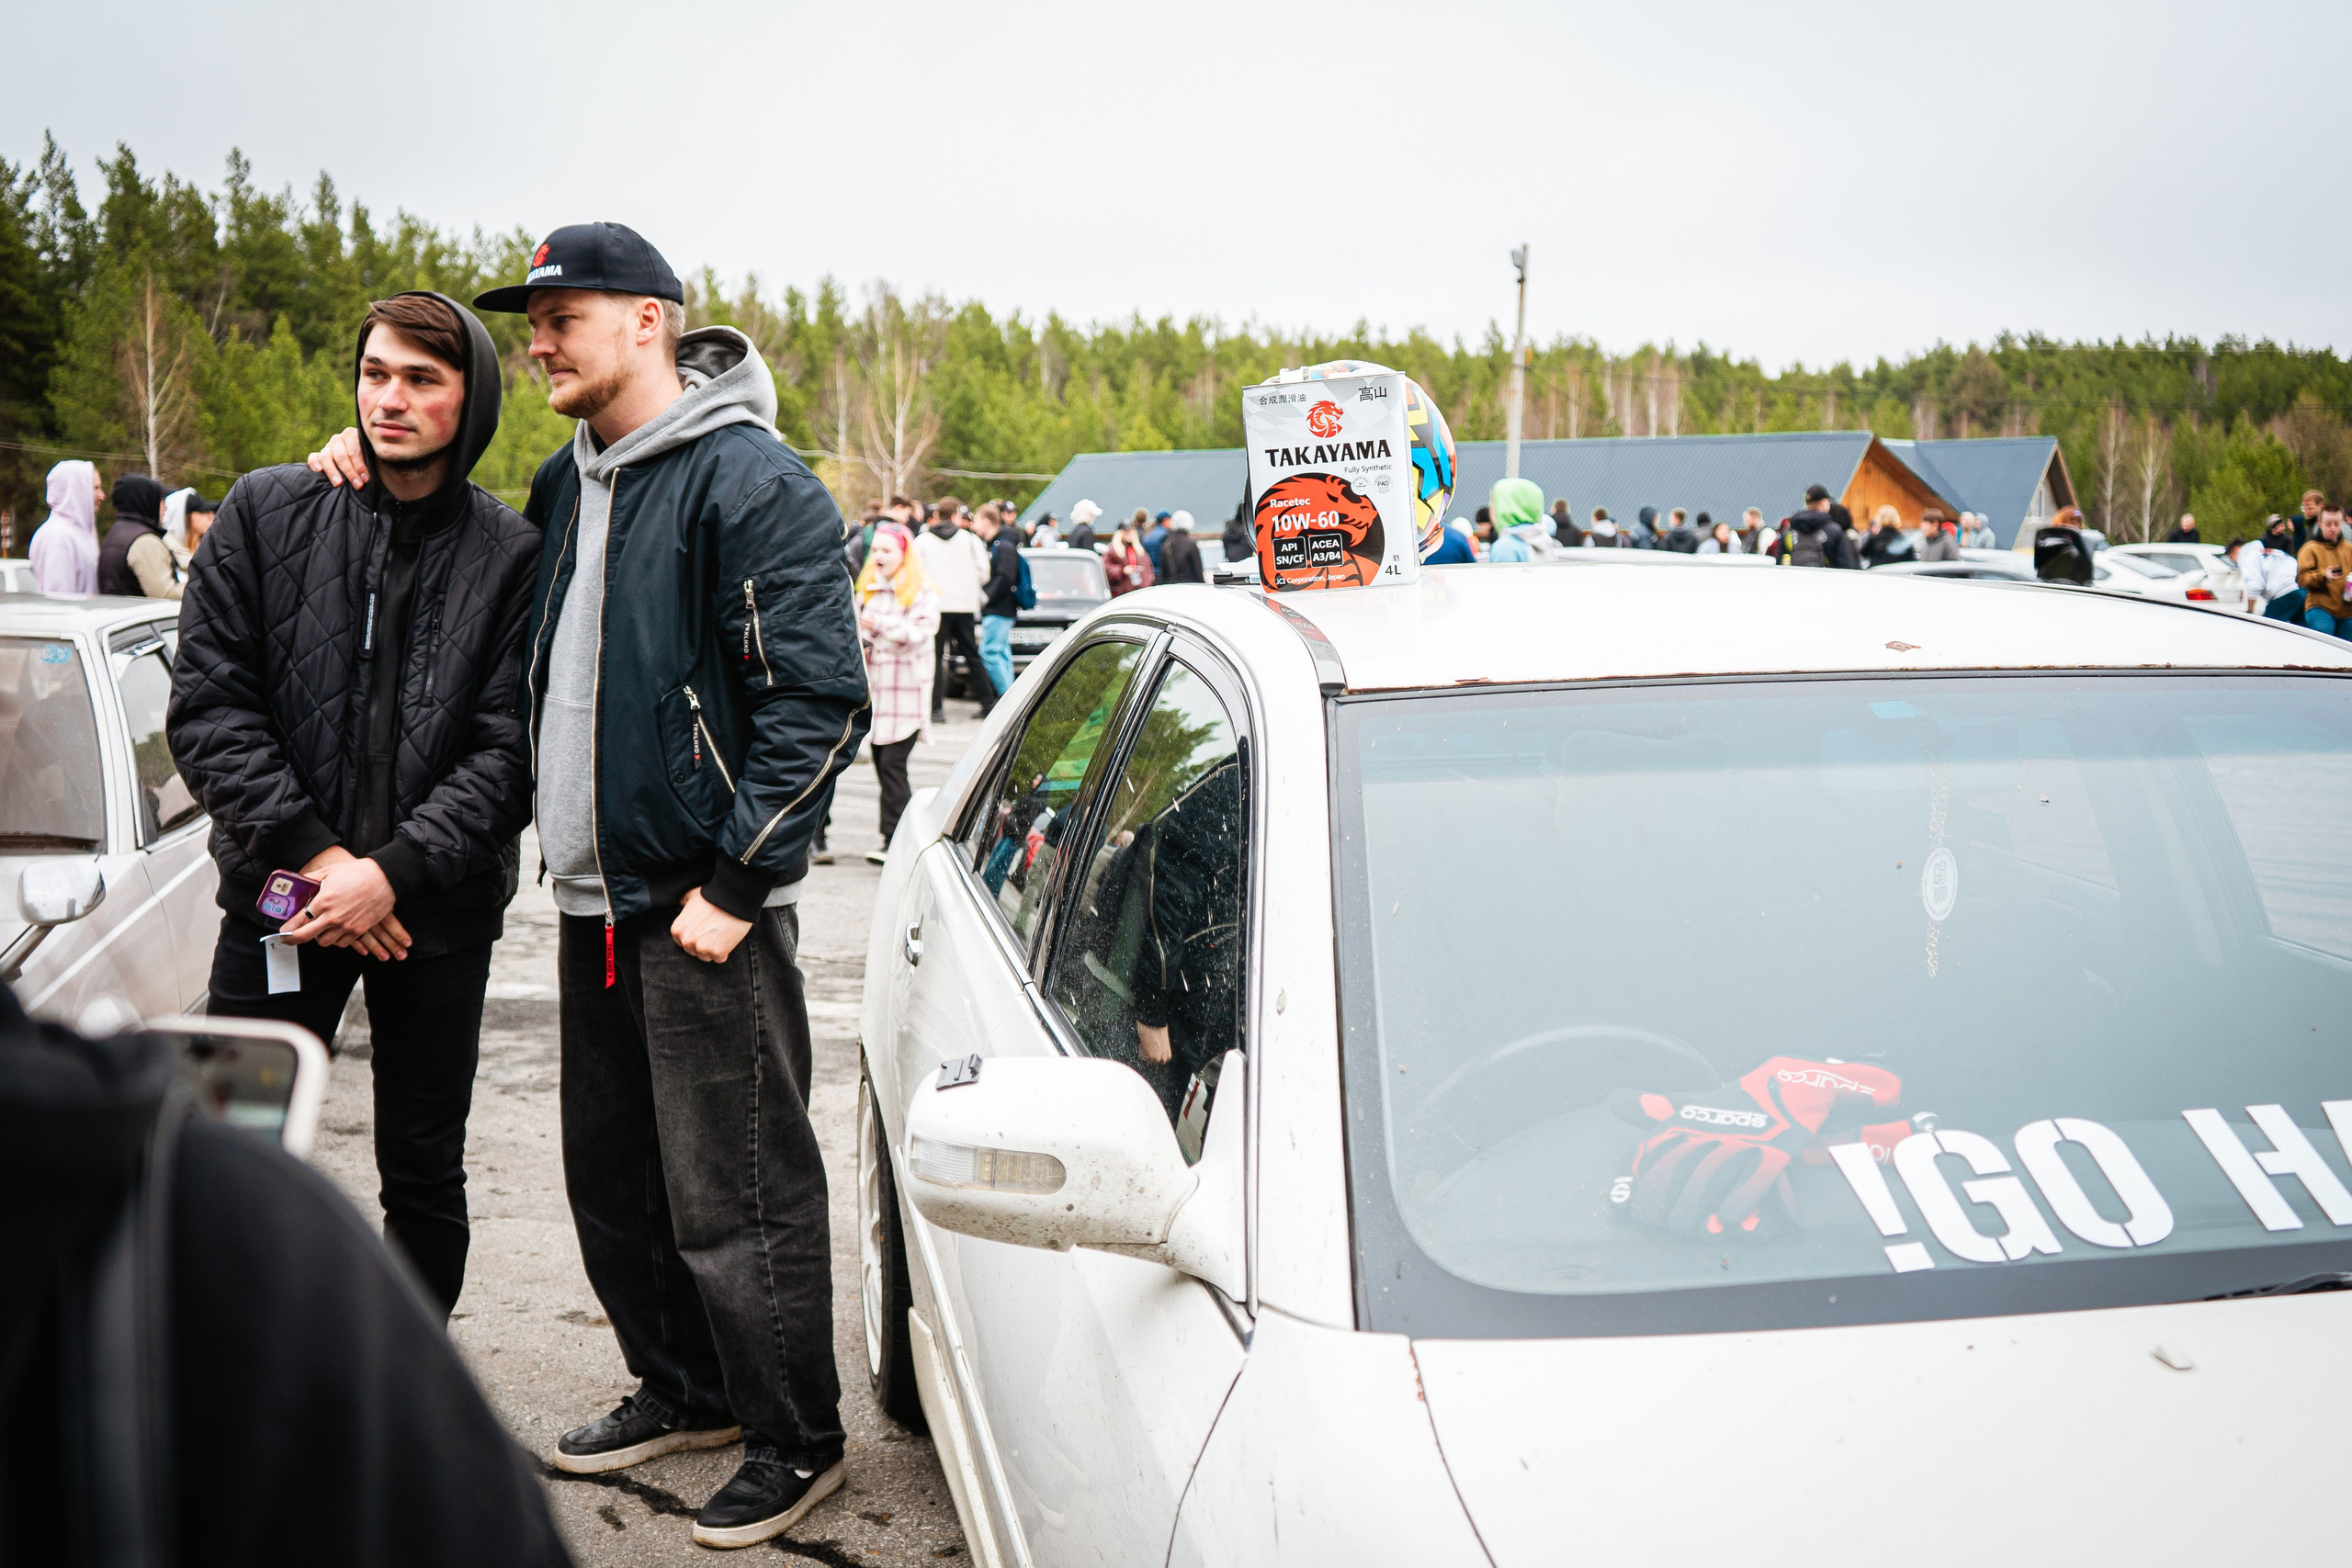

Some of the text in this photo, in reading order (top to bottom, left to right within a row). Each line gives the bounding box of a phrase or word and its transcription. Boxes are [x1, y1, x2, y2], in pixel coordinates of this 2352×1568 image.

[1358, 387, 1387, 402] 高山
[1265, 439, 1392, 467] TAKAYAMA
[1344, 464, 1392, 474] Fully Synthetic
[1270, 498, 1311, 508] Racetec
[1272, 511, 1340, 532] 10W-60
[1281, 543, 1297, 552] API
[1311, 539, 1340, 549] ACEA
[1276, 554, 1305, 565] SN/CF
[1313, 551, 1341, 562] A3/B4
[1276, 573, 1346, 585] JCI Corporation, Japan
[1679, 1106, 1768, 1128] sparco
[1828, 1117, 2174, 1273] !GO
